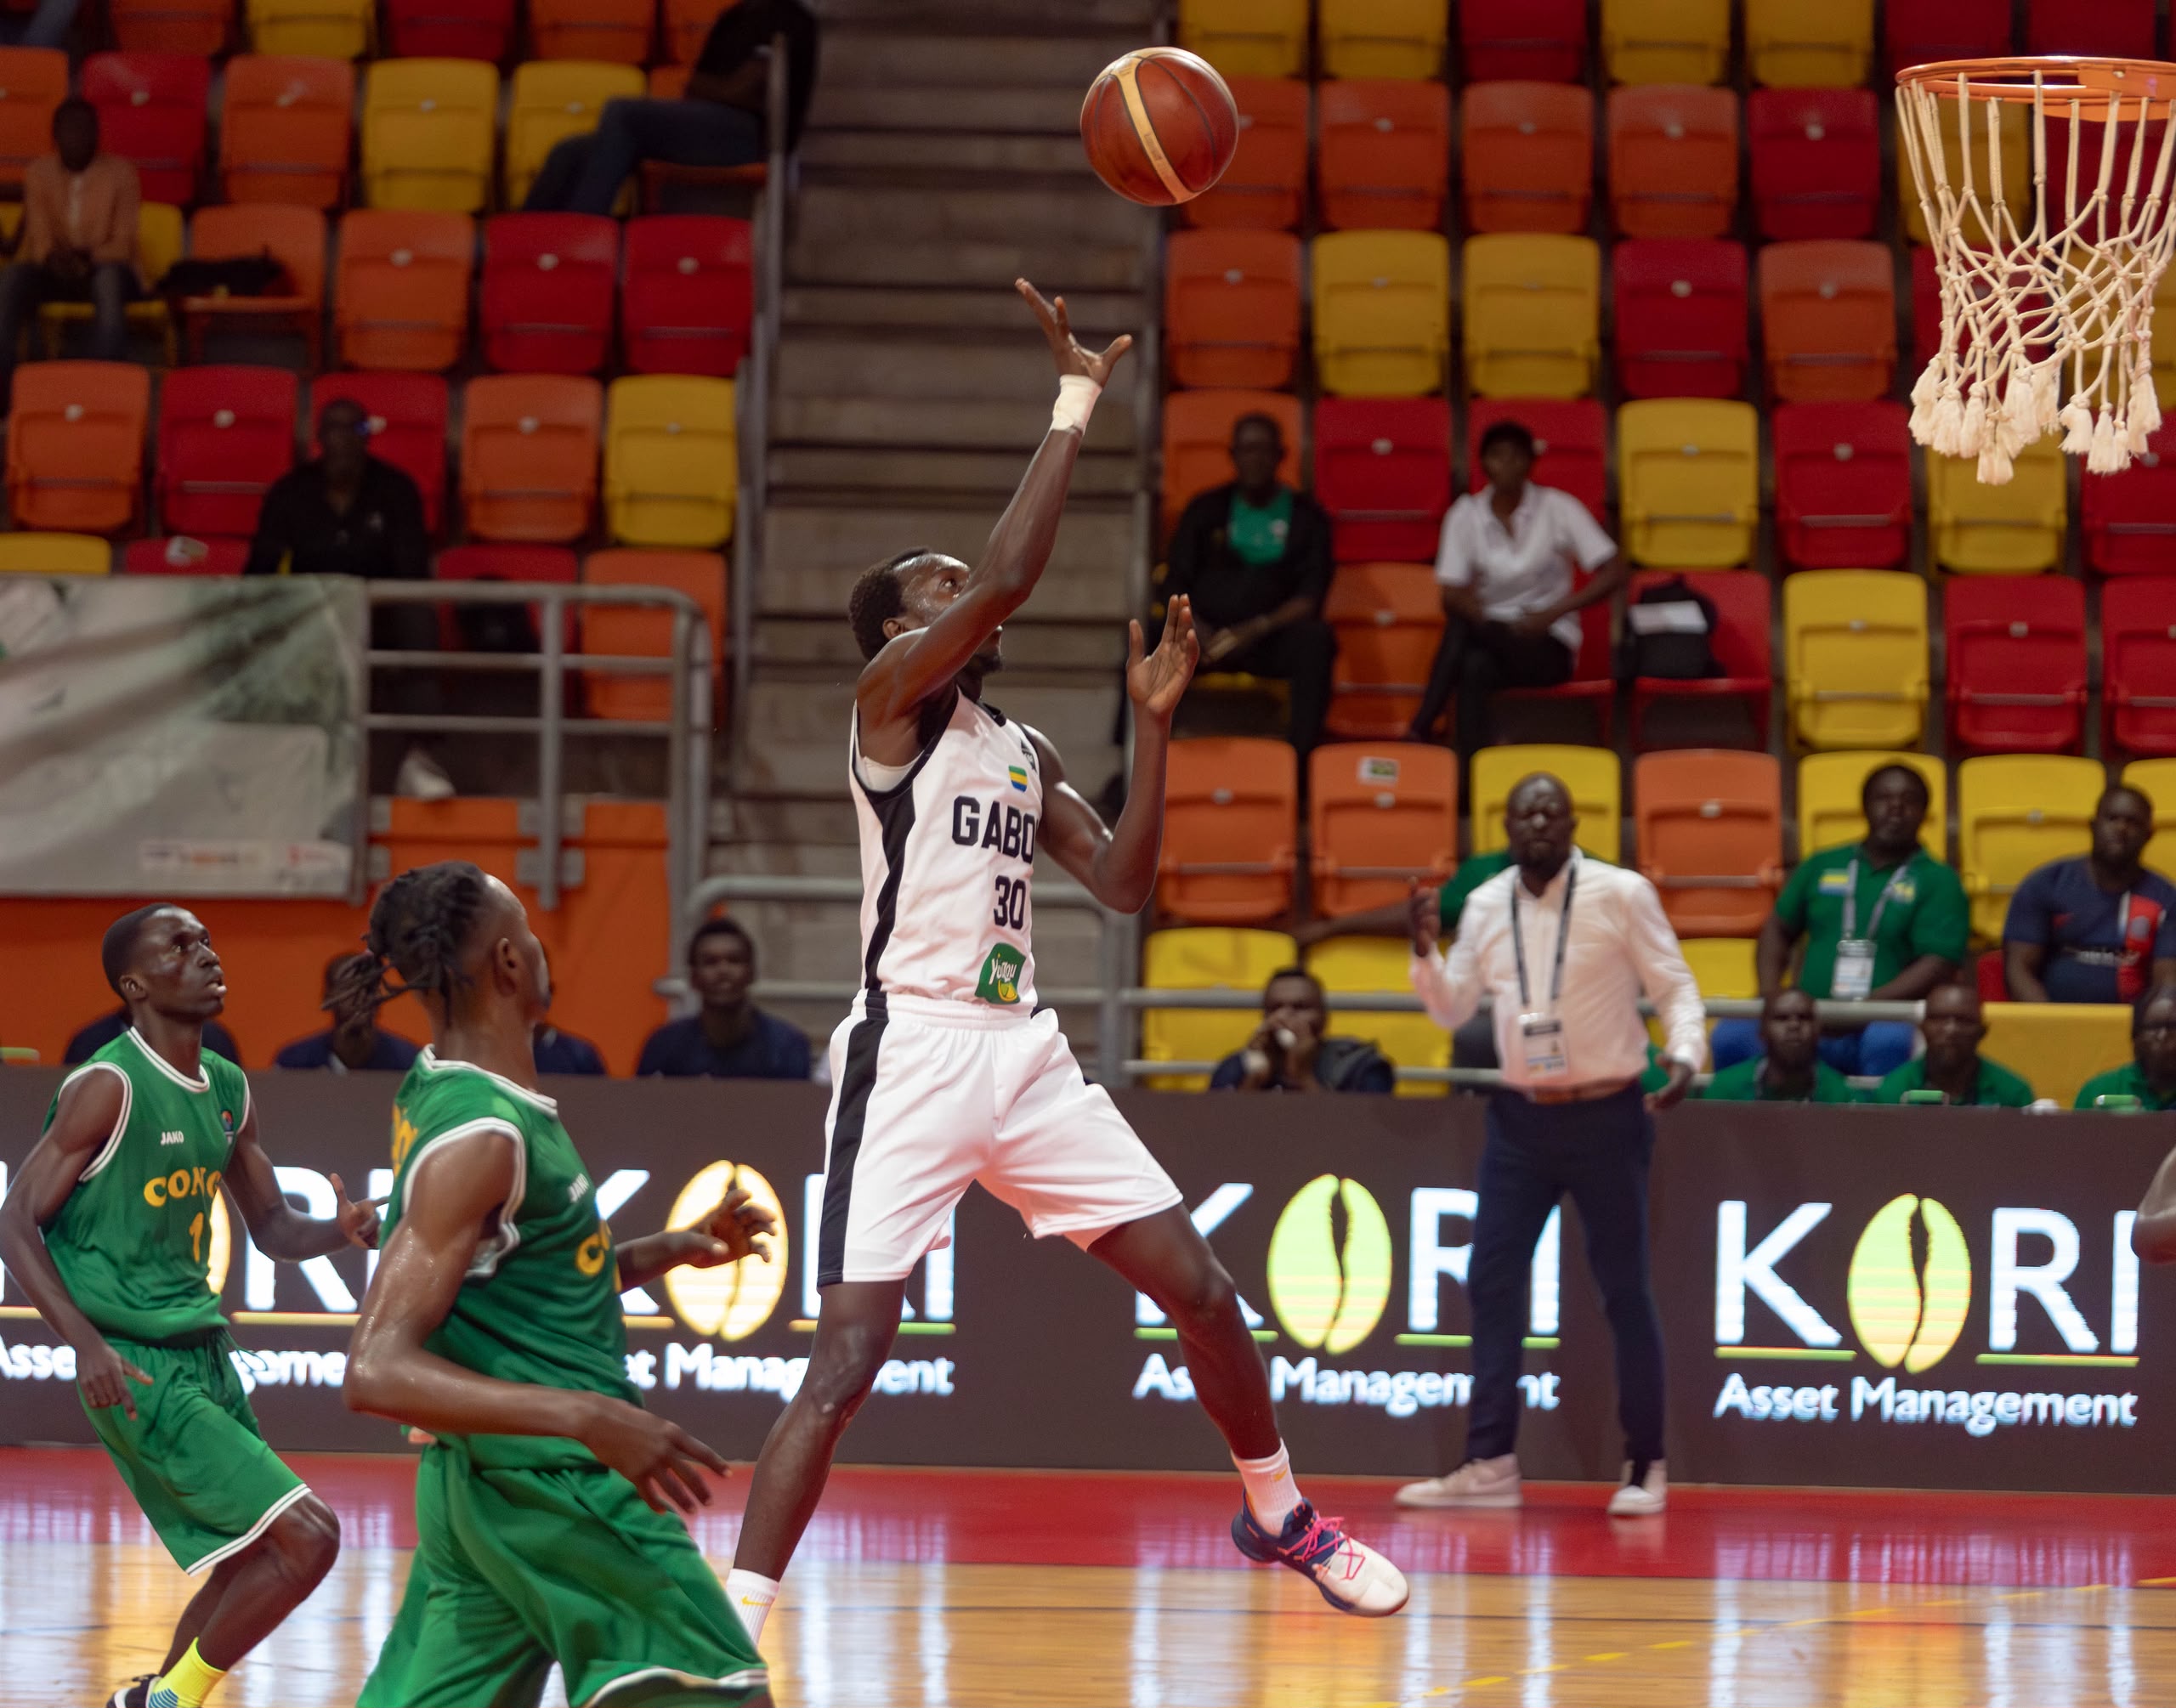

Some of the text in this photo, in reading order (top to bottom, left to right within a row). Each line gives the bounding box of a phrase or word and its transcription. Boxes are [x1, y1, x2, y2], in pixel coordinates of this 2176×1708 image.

[952, 795, 1039, 865] GABO
[994, 874, 1026, 930] 30
[161, 1130, 184, 1145] JAKO
[144, 1166, 223, 1208] CONG
[1714, 1193, 2140, 1375] KORI
[0, 1334, 76, 1381] sse
[665, 1342, 956, 1405] Managent
[1270, 1355, 1561, 1417] Managemnt
[1713, 1372, 2139, 1438] Asset Management
